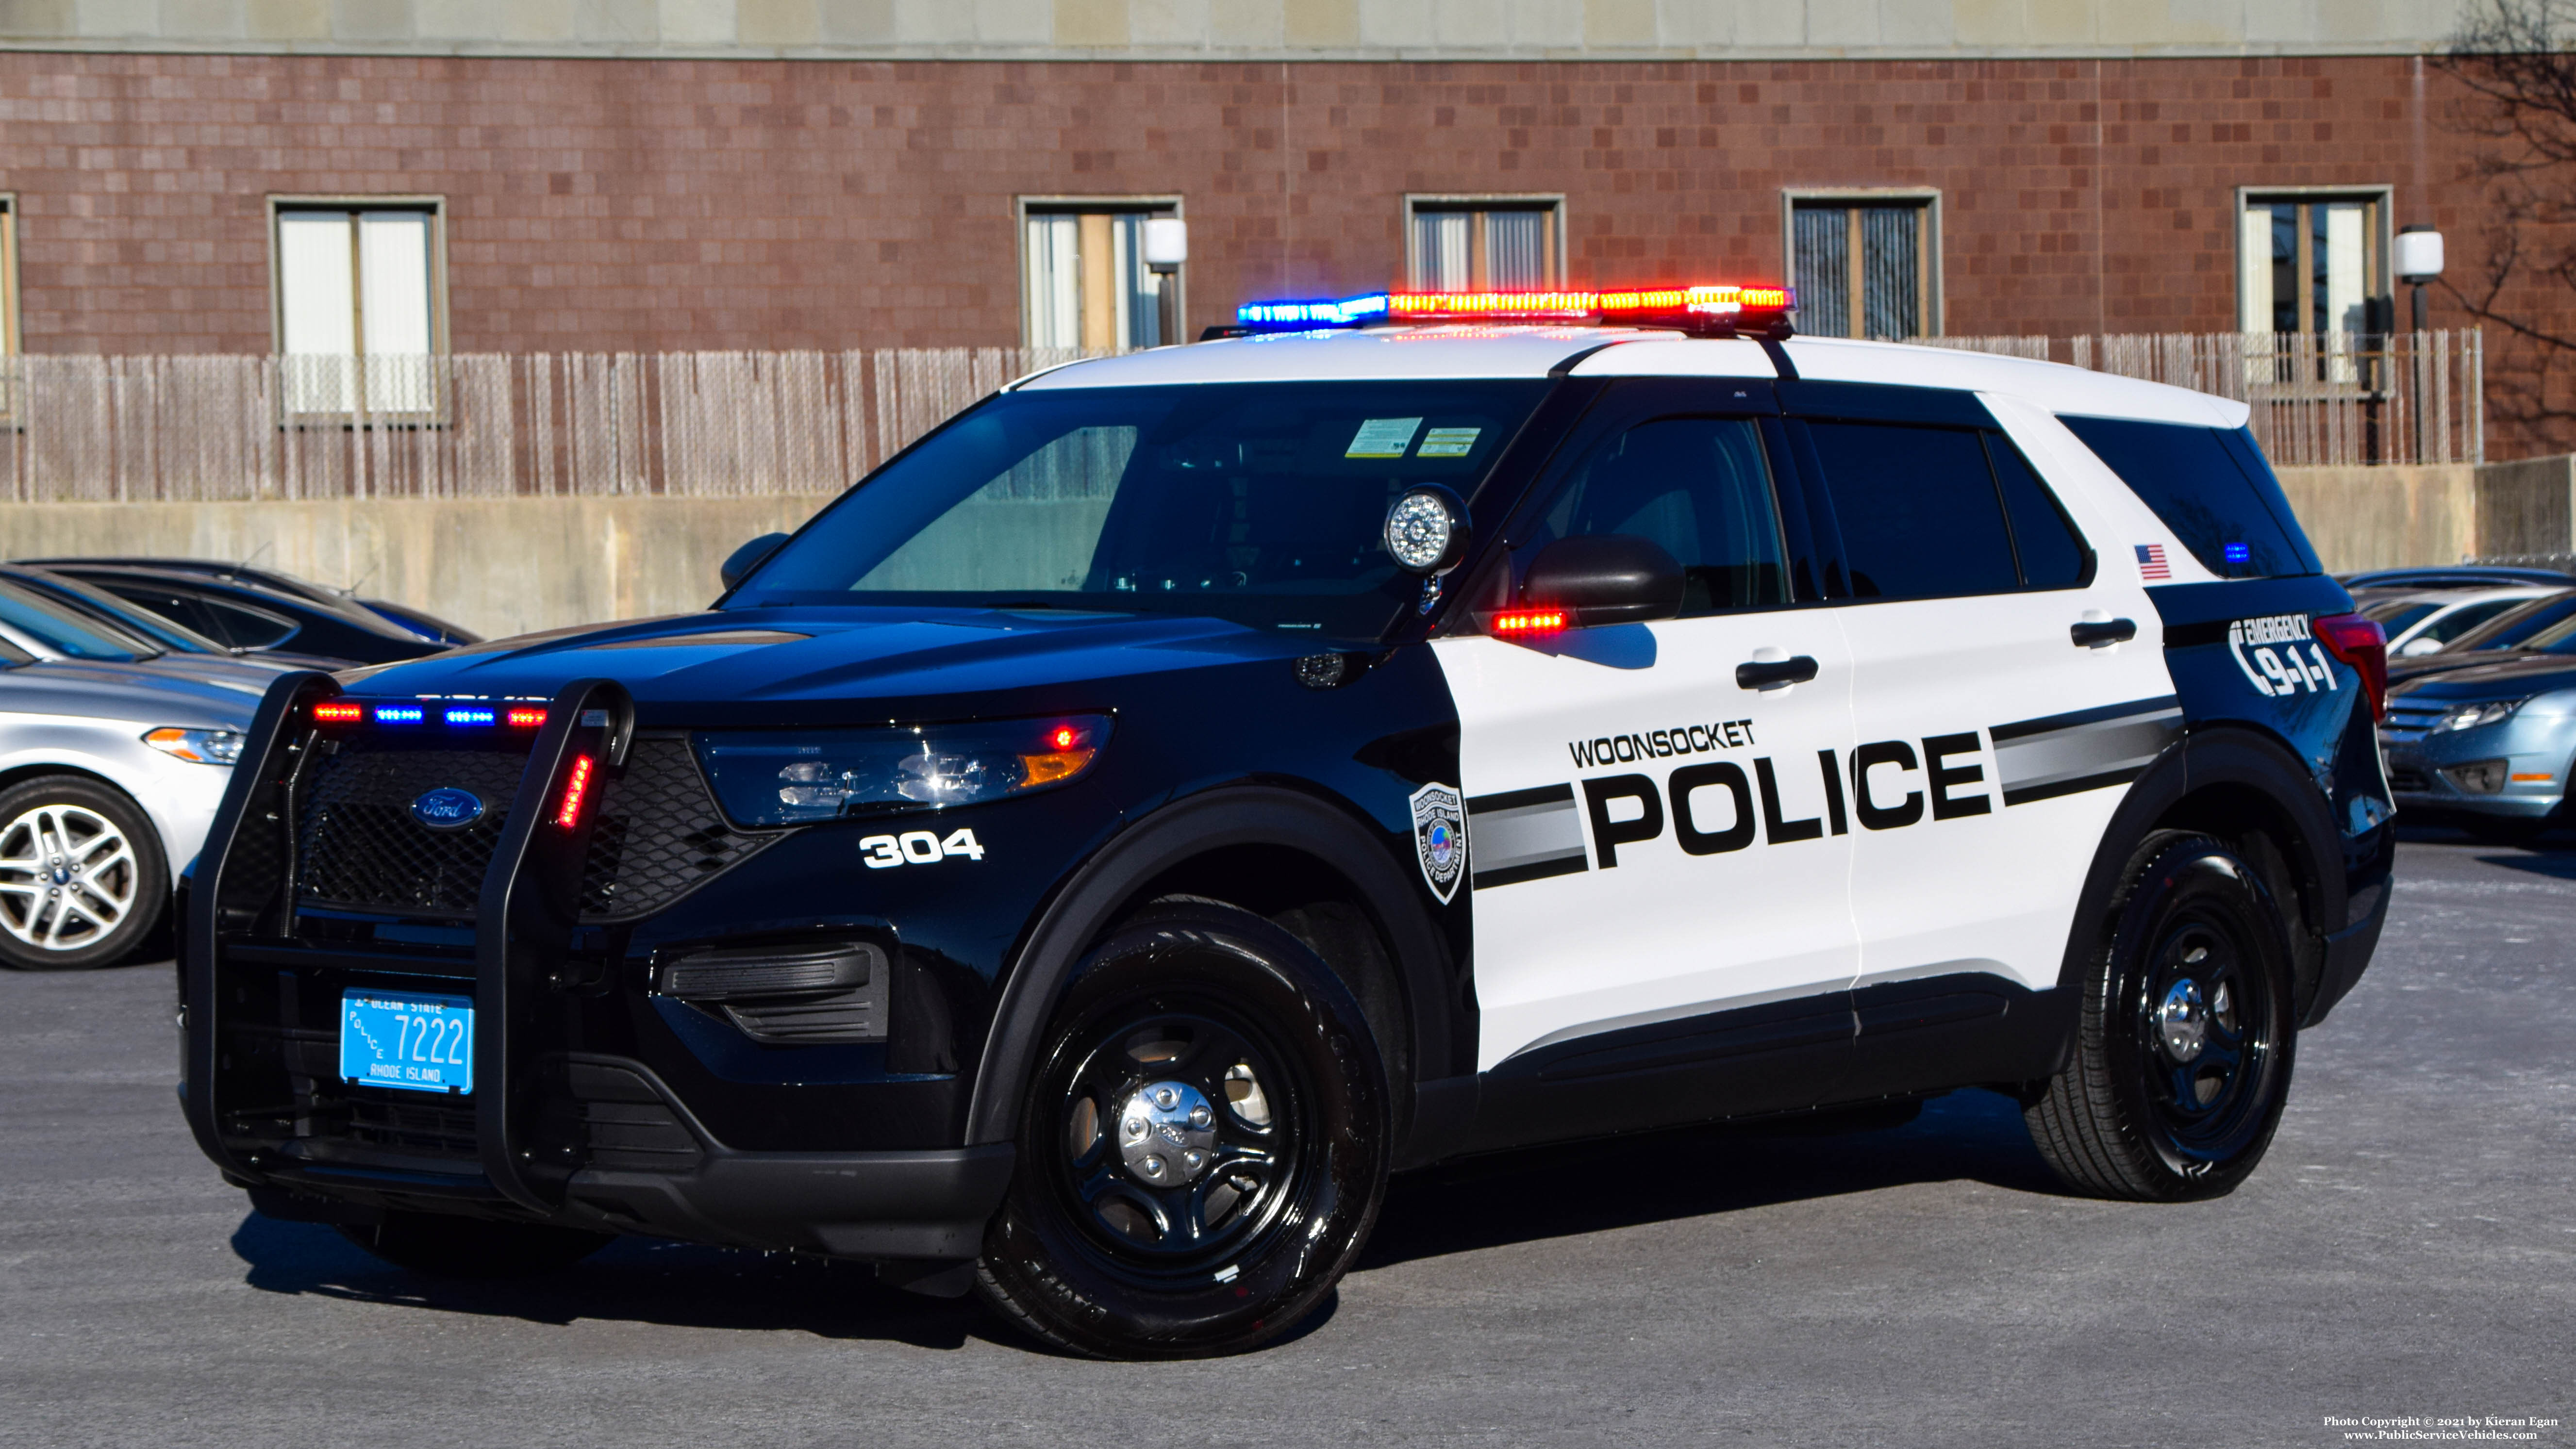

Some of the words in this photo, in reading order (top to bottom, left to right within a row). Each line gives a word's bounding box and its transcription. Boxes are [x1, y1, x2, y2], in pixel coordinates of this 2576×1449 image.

[2244, 614, 2311, 646] EMERGENCY
[2254, 643, 2338, 695] 9-1-1
[1568, 718, 1755, 769] WOONSOCKET
[1415, 791, 1456, 810] WOONSOCKET
[1417, 809, 1436, 827] RHODE
[1437, 808, 1459, 822] ISLAND
[1581, 731, 1992, 870] POLICE
[859, 828, 985, 869] 304
[1420, 835, 1435, 876] POLICE
[1435, 832, 1463, 883] DEPARTMENT
[371, 999, 404, 1011] OCEAN
[410, 1003, 442, 1014] STATE
[349, 1011, 383, 1059] POLICE
[395, 1015, 463, 1065] 7222
[370, 1063, 401, 1079] RHODE
[406, 1067, 440, 1083] ISLAND
